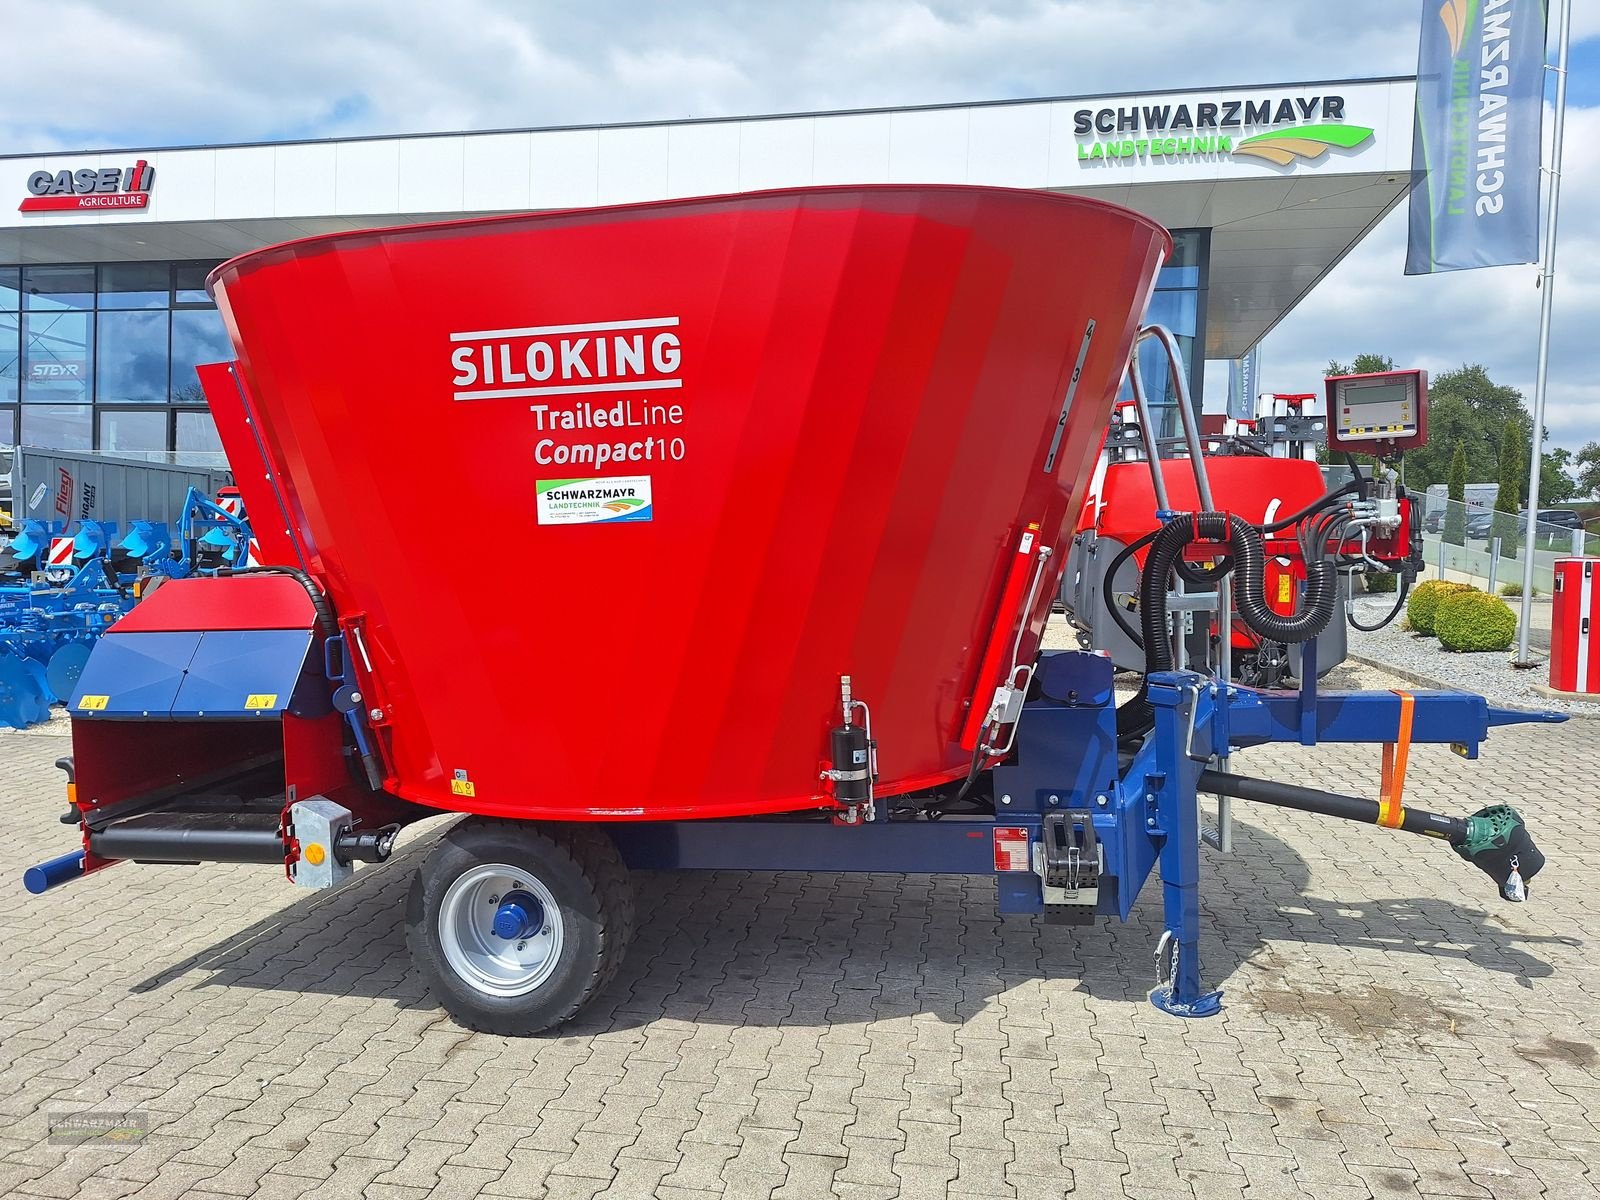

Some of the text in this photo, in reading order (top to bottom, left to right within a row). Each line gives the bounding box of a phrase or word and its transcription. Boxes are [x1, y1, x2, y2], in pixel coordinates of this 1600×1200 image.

[1073, 95, 1345, 135] SCHWARZMAYR
[1077, 136, 1232, 160] LANDTECHNIK
[26, 167, 121, 195] CASE
[78, 195, 142, 207] AGRICULTURE
[31, 364, 79, 376] STEYR
[451, 332, 682, 386] SILOKING
[1048, 323, 1094, 468] 4 3 2 1
[530, 399, 683, 430] TrailedLine
[534, 436, 685, 470] Compact10
[56, 466, 73, 515] Fliegl
[546, 488, 635, 501] SCHWARZMAYR
[549, 502, 601, 510] LANDTECHNIK
